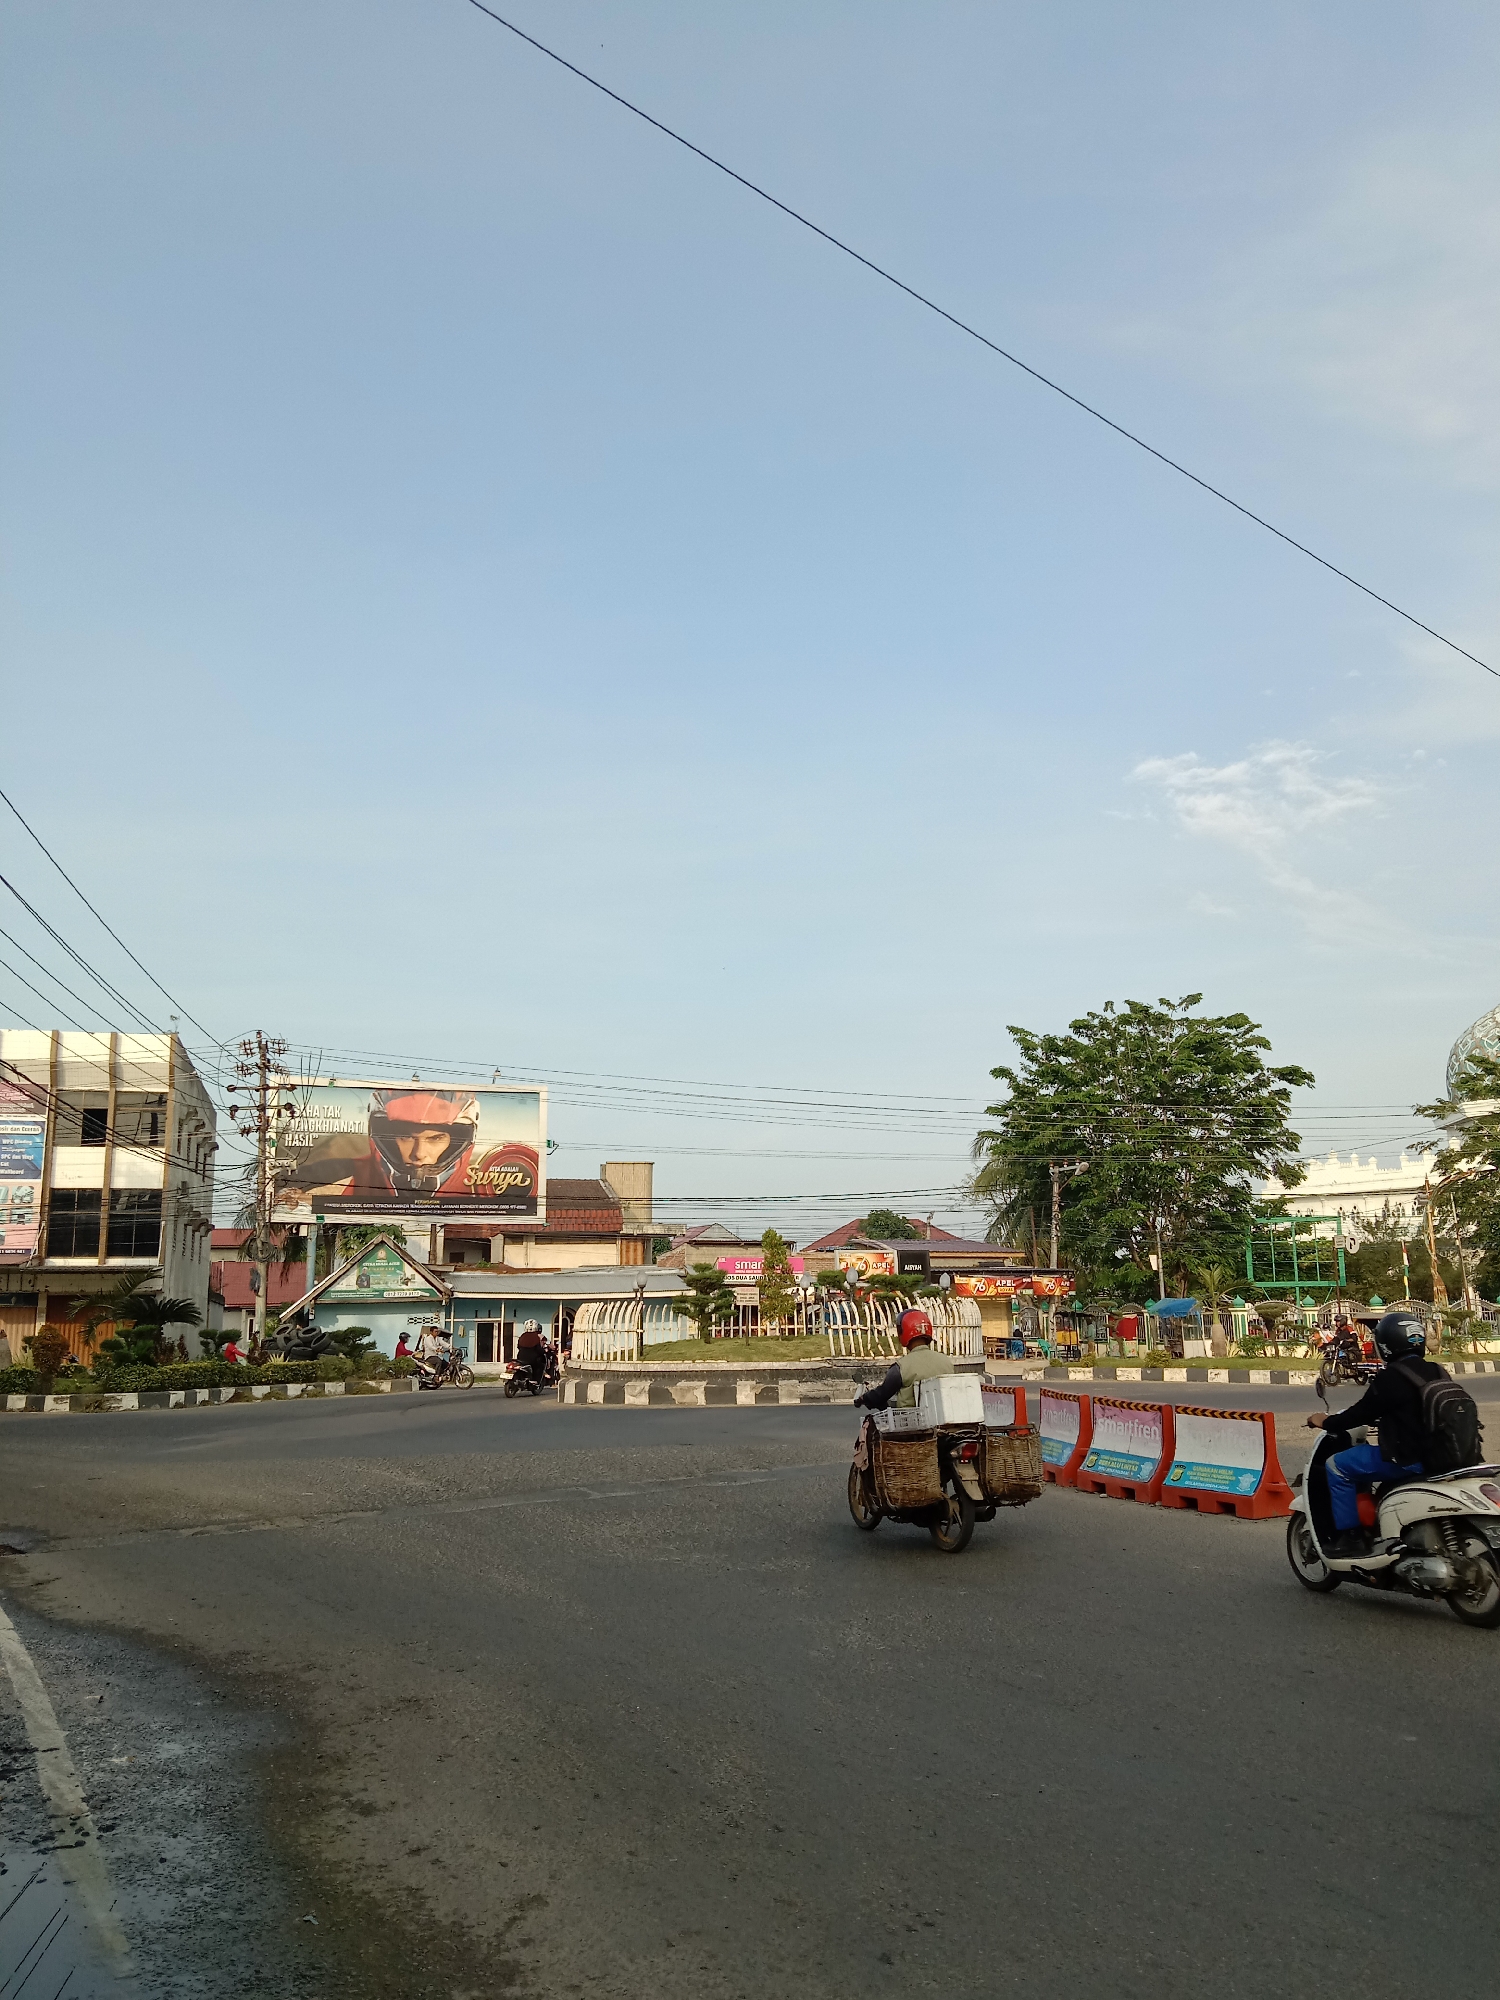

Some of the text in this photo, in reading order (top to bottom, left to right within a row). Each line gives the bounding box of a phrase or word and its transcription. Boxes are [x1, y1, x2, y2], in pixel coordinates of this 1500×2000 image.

[285, 1105, 342, 1119] SAHA TAK
[463, 1164, 531, 1195] Surya
[974, 1279, 986, 1295] 76
[1045, 1279, 1055, 1295] 76
[1043, 1407, 1079, 1426] smartfren
[1096, 1418, 1159, 1441] smartfren
